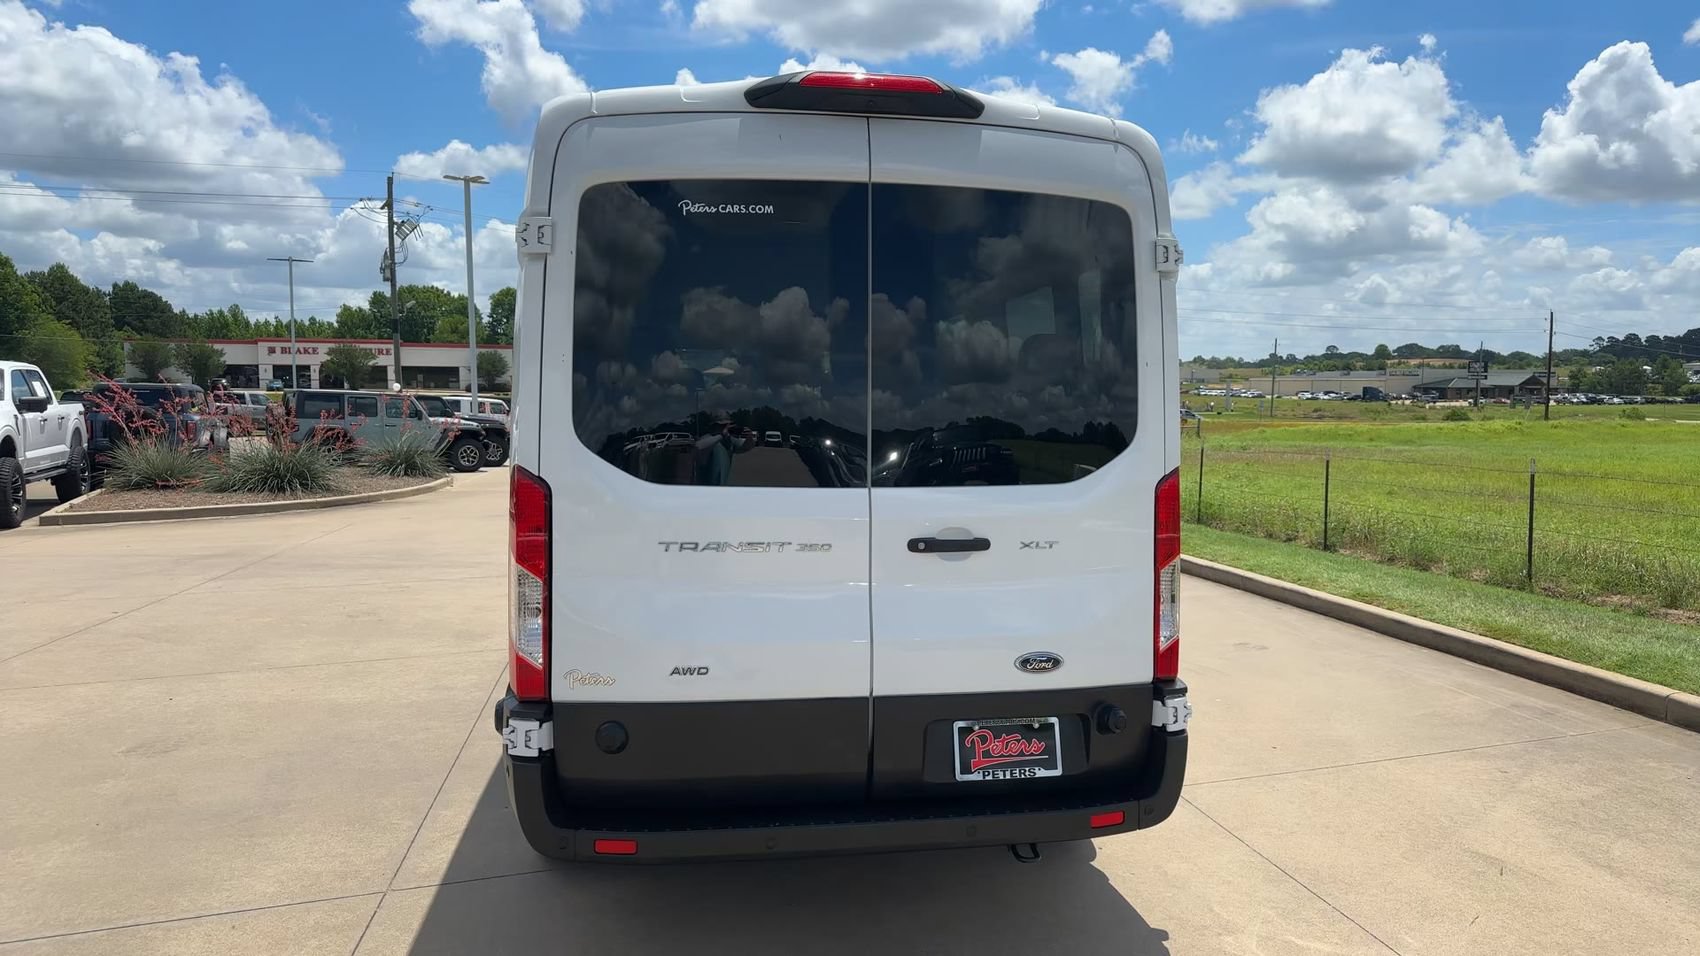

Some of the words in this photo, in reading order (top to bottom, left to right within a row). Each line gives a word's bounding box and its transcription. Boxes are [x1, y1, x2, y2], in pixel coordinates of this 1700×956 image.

[678, 200, 717, 216] Peters
[718, 204, 774, 214] CARS.COM
[658, 541, 792, 553] TRANSIT
[795, 543, 832, 553] 350
[1019, 541, 1059, 550] XLT
[1026, 657, 1054, 670] Ford
[669, 666, 709, 676] AWD
[563, 669, 616, 690] Peters
[965, 729, 1046, 762] Peters
[982, 768, 1037, 779] PETERS
